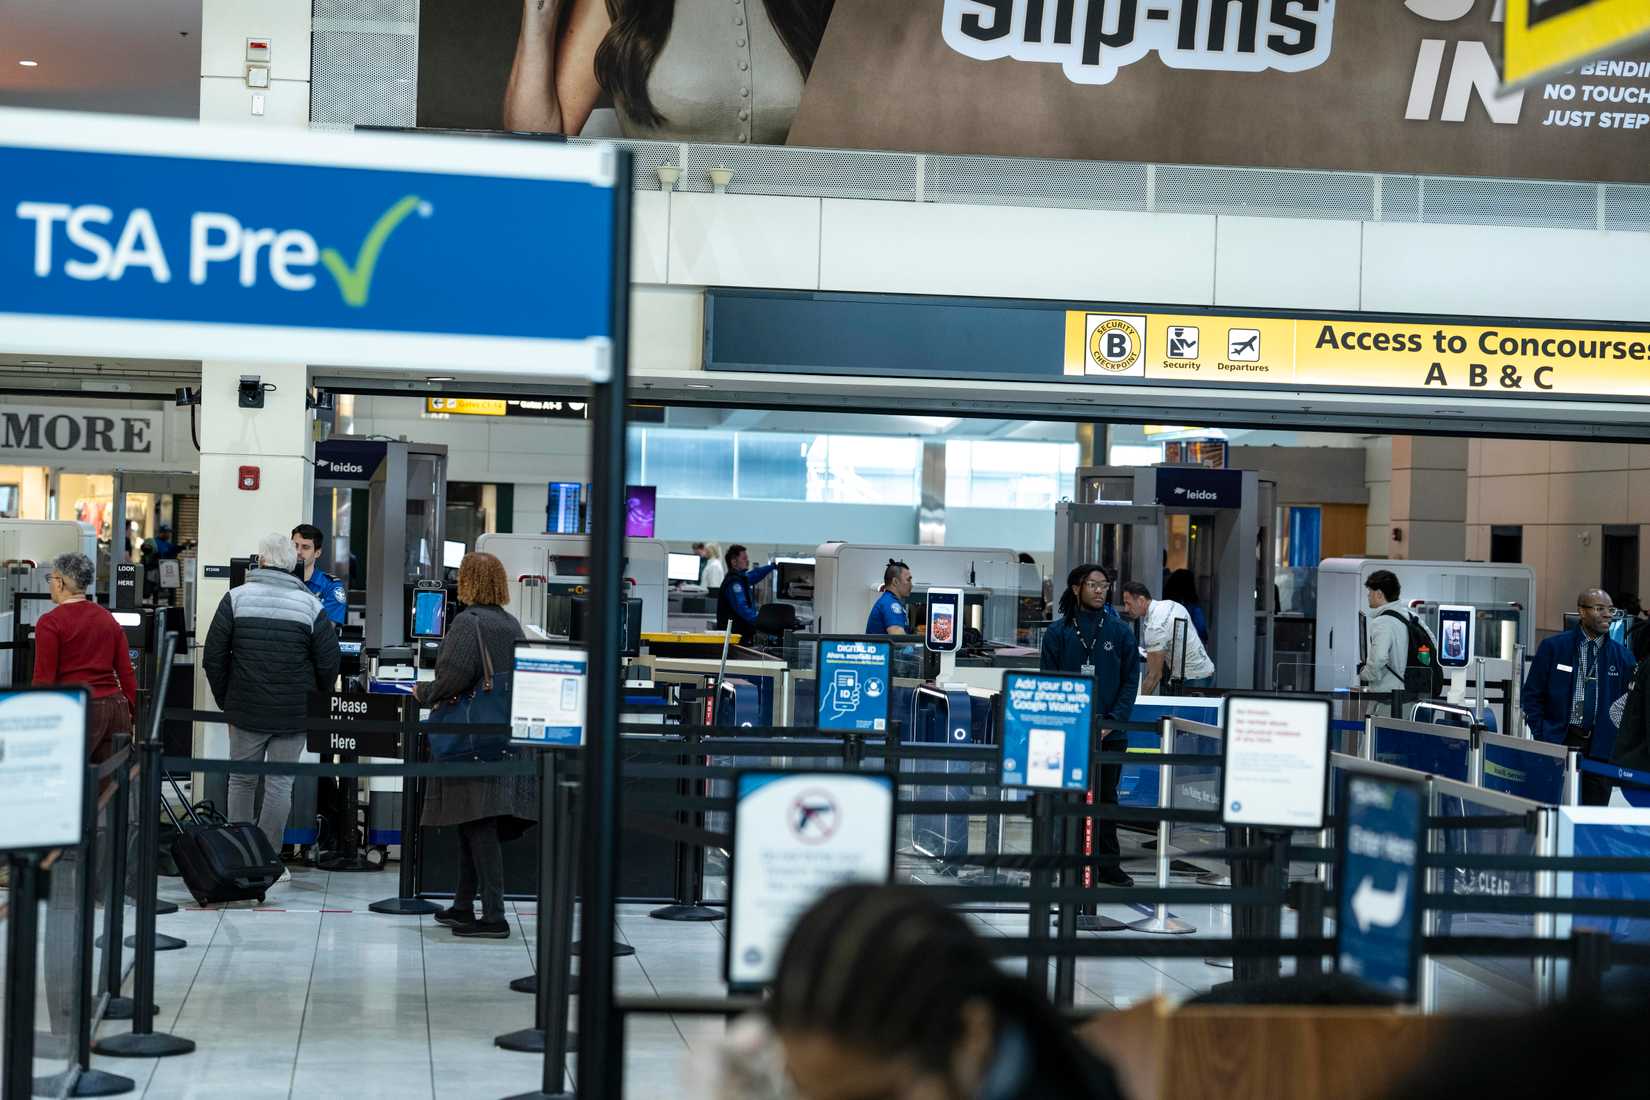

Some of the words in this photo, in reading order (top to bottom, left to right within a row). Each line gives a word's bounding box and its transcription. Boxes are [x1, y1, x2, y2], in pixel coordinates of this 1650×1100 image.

[1580, 60, 1650, 77] BENDI
[1405, 39, 1525, 124] IN
[1543, 84, 1576, 101] NO
[1581, 85, 1650, 104] TOUCH
[1541, 109, 1596, 128] JUST
[1598, 112, 1650, 129] STEP
[16, 201, 171, 284] TSA
[189, 211, 319, 292] Pre
[1097, 321, 1135, 335] SECURITY
[1107, 333, 1127, 358] B
[1315, 325, 1422, 352] Access
[1433, 329, 1467, 354] to
[1478, 331, 1650, 360] Concourse
[1093, 351, 1137, 370] CHECKPOINT
[1163, 360, 1201, 371] Security
[1217, 362, 1269, 373] Departures
[1424, 362, 1448, 386] A
[1469, 364, 1488, 387] B
[1499, 364, 1522, 389] &
[1533, 366, 1554, 390] C
[1, 412, 151, 453] MORE
[330, 462, 363, 473] leidos
[1186, 489, 1217, 500] leidos
[840, 689, 851, 698] ID
[1015, 678, 1036, 689] Add
[1037, 681, 1060, 692] your
[1061, 681, 1073, 691] ID
[1074, 682, 1086, 692] to
[330, 696, 368, 713] Please
[1010, 689, 1034, 701] your
[1034, 691, 1066, 703] phone
[1066, 692, 1090, 704] with
[1013, 700, 1047, 712] Google
[330, 733, 356, 750] Here
